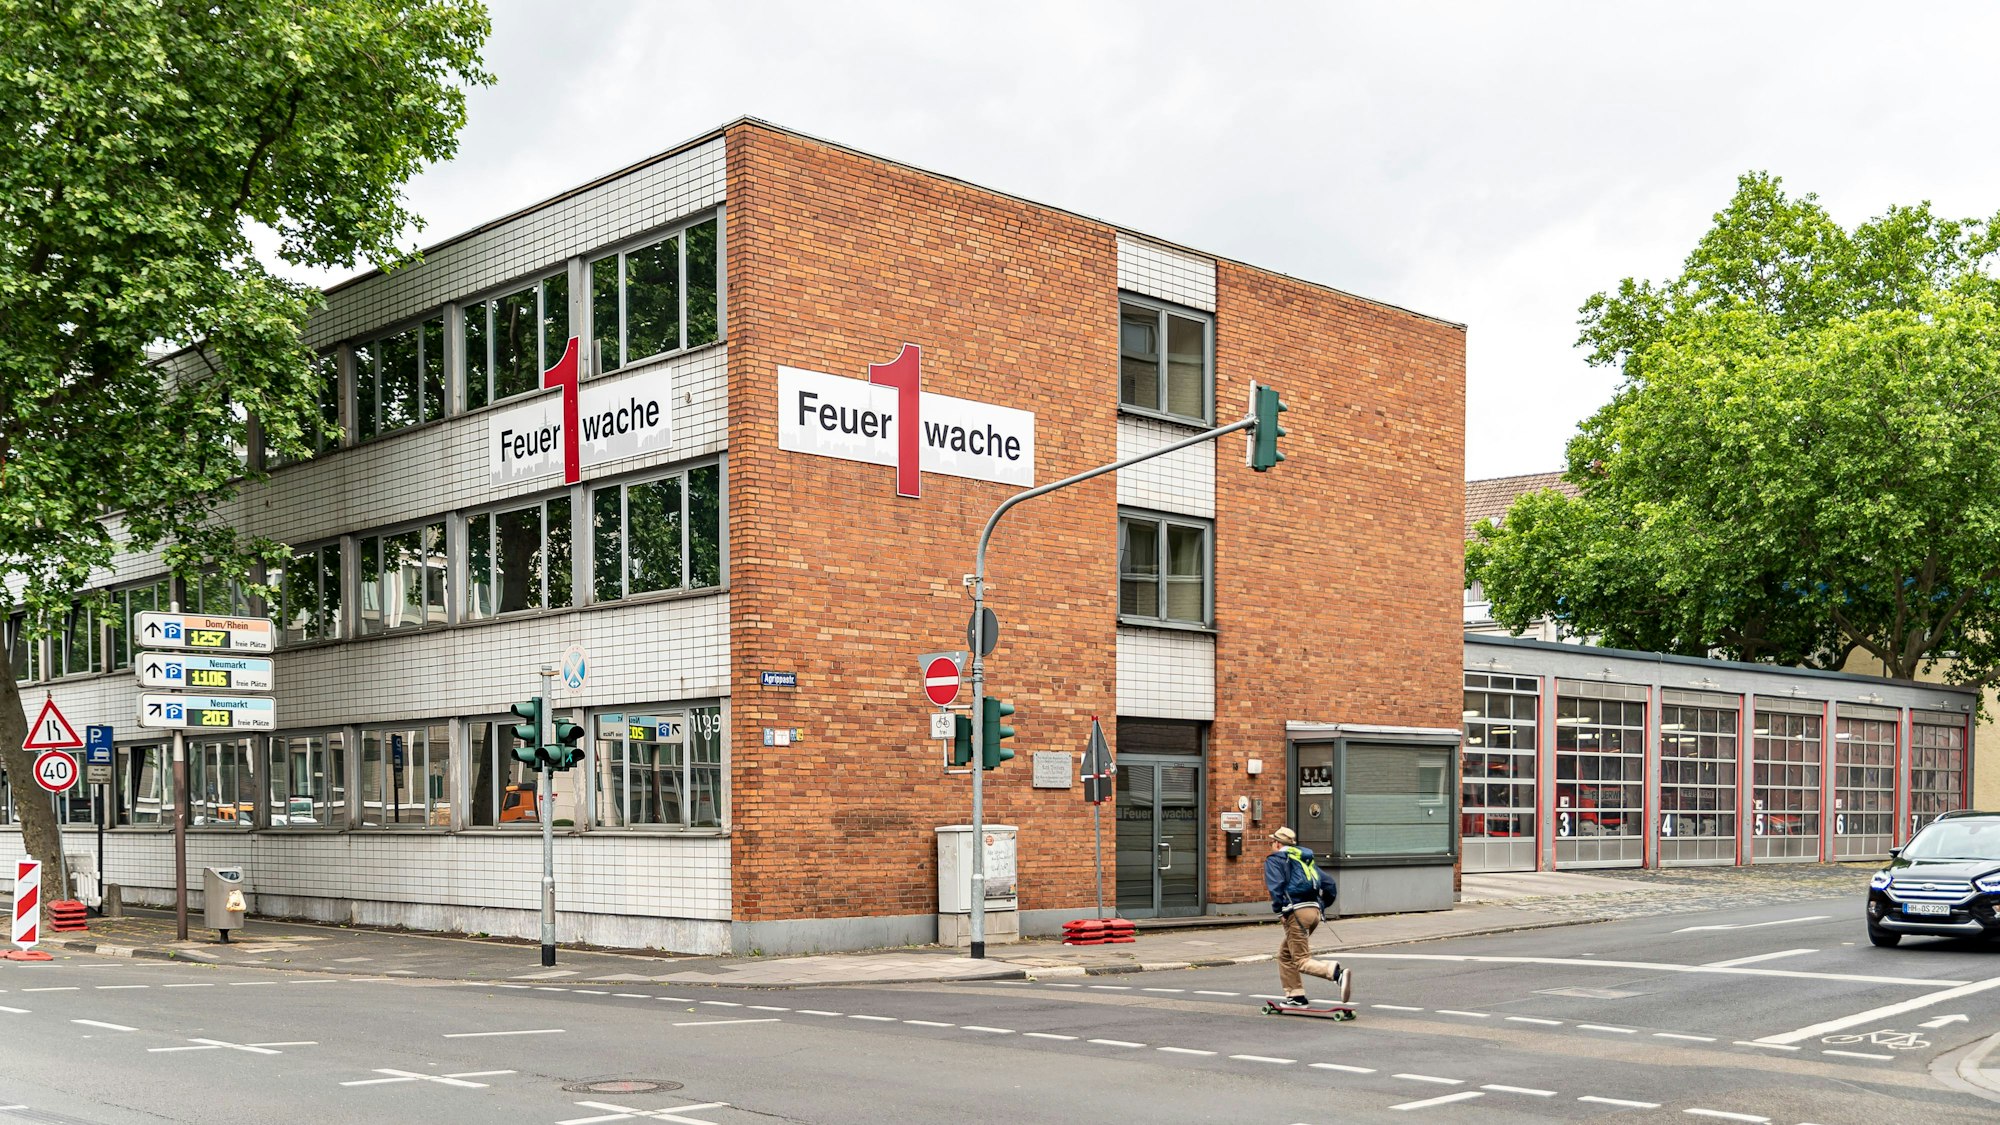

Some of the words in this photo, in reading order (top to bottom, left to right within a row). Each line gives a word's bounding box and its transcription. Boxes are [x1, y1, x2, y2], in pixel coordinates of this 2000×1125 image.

[501, 424, 561, 462] Feuer
[543, 336, 580, 485] 1
[582, 397, 660, 442] wache
[798, 390, 893, 439] Feuer
[869, 342, 921, 498] 1
[924, 421, 1021, 461] wache
[205, 620, 249, 630] Dom/Rhein
[190, 630, 226, 647] 1257
[209, 660, 247, 669] Neumarkt
[191, 669, 227, 687] 1106
[210, 699, 248, 709] Neumarkt
[202, 710, 229, 726] 203
[43, 762, 67, 779] 40
[1123, 807, 1152, 819] Feuer
[1161, 807, 1193, 819] wache
[1559, 812, 1570, 837] 3
[1662, 814, 1672, 837] 4
[1755, 814, 1764, 836] 5
[1836, 814, 1844, 835] 6
[1911, 815, 1919, 834] 7
